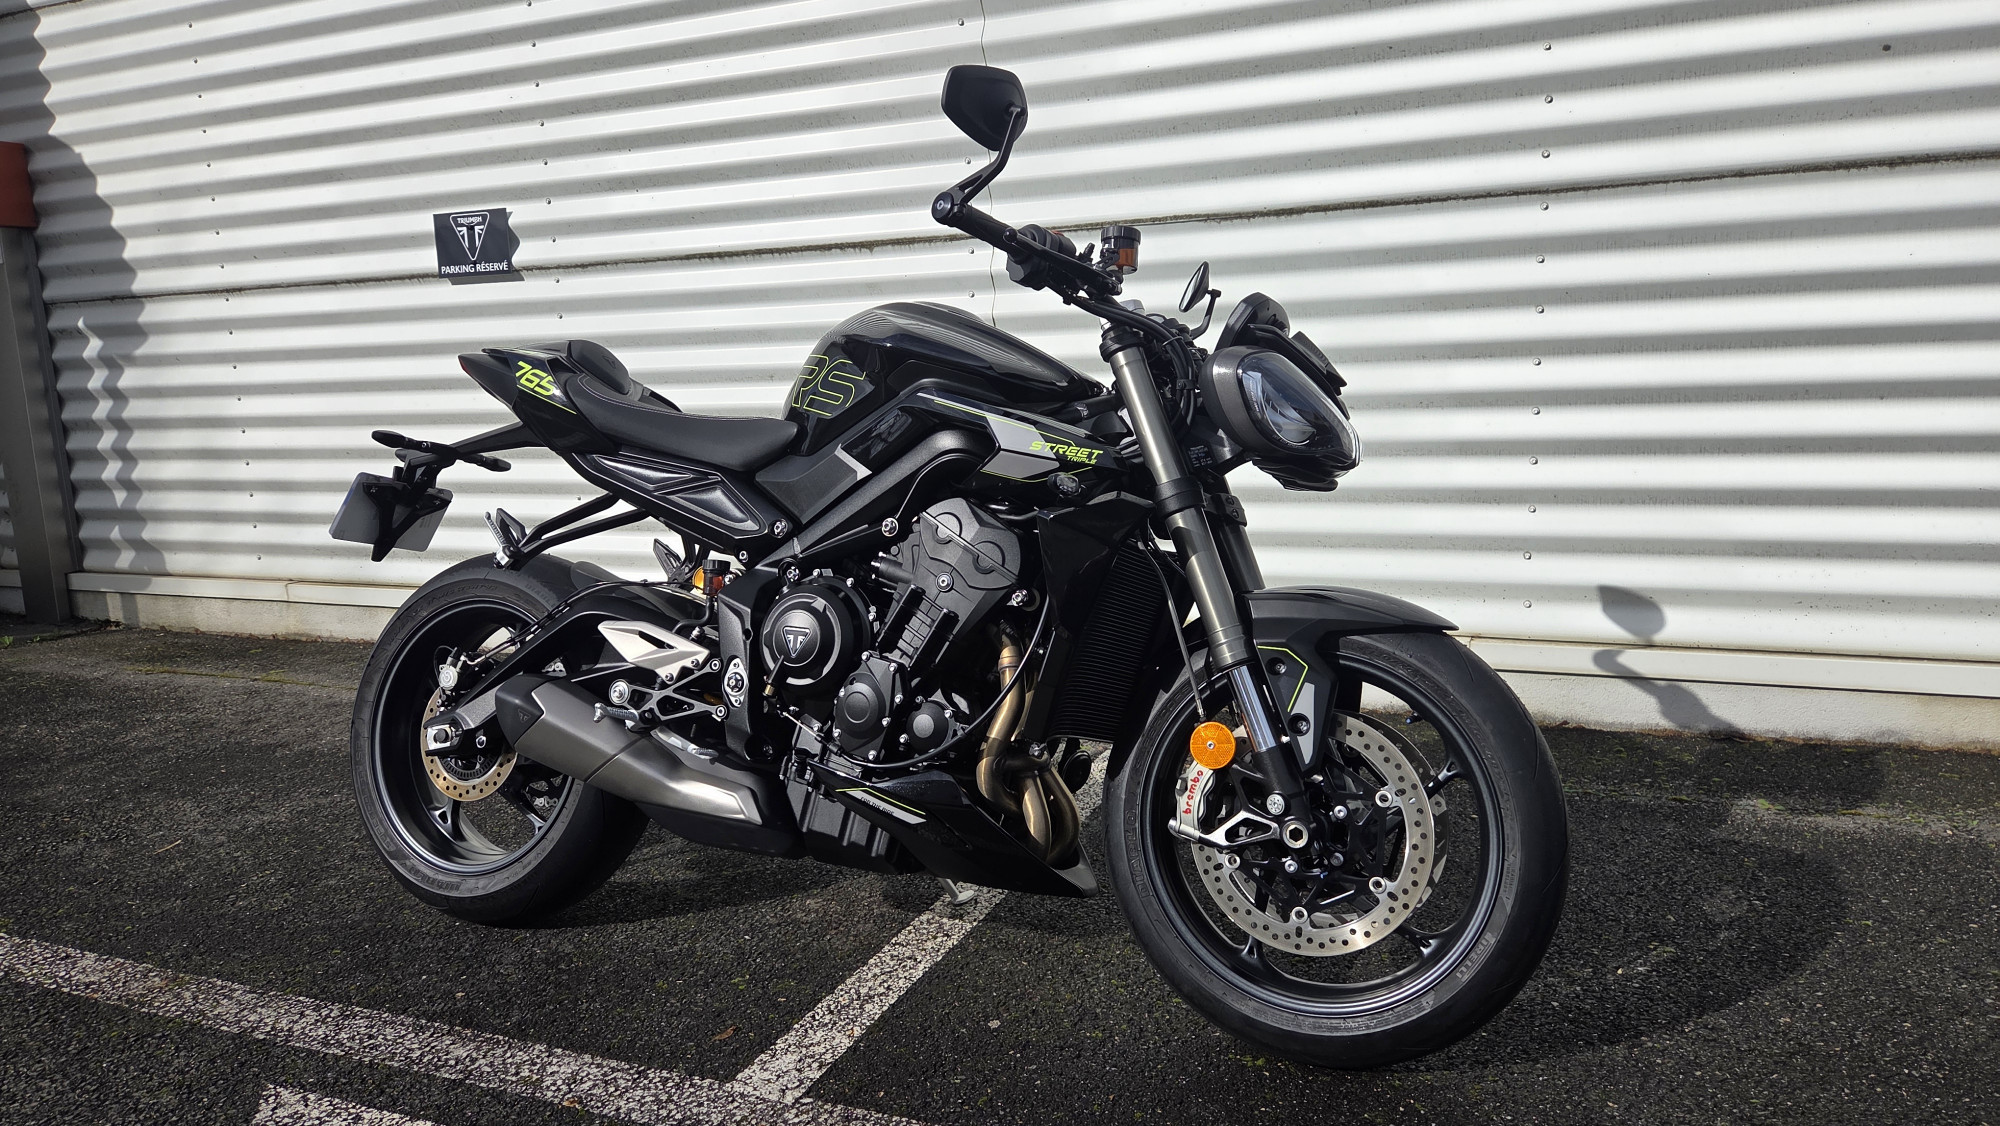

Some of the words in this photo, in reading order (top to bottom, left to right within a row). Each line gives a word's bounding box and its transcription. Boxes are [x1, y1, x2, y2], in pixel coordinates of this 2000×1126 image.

[457, 215, 482, 224] TRIUMPH
[441, 264, 475, 274] PARKING
[476, 259, 508, 272] RÉSERVÉ
[515, 360, 554, 396] 765
[792, 354, 866, 417] RS
[1029, 440, 1103, 459] STREET
[1067, 455, 1098, 465] TRIPLE
[1182, 769, 1204, 815] brembo
[1456, 932, 1497, 982] PIRELLI
